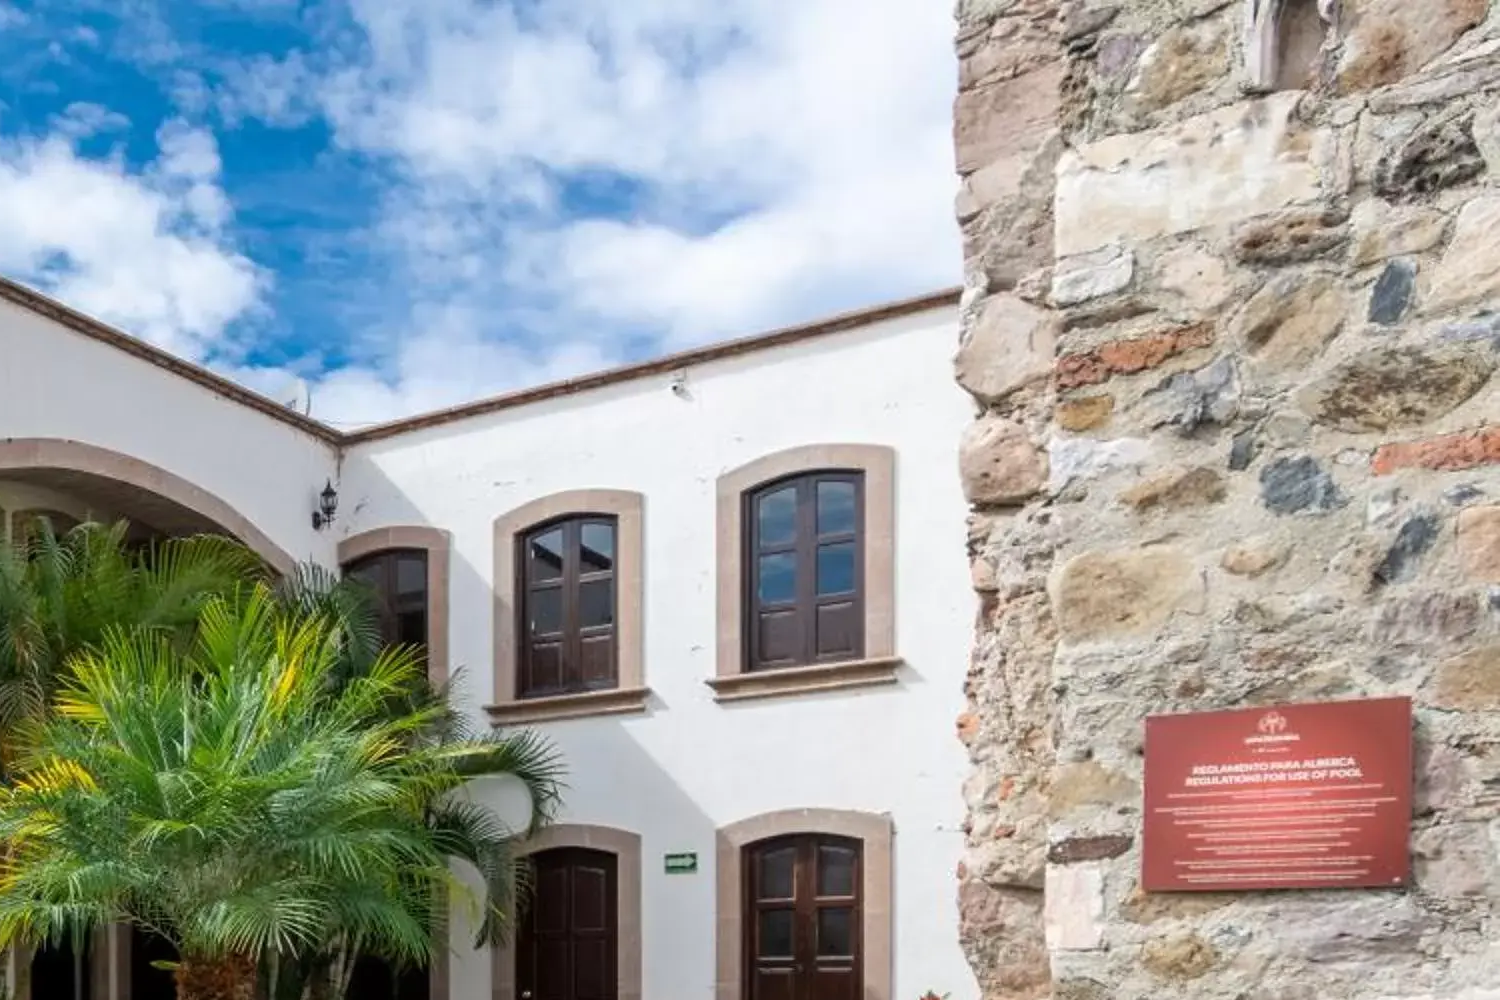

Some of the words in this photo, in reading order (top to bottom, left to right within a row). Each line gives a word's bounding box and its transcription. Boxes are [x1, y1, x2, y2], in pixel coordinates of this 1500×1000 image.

[1193, 763, 1269, 774] REGLAMENTO
[1271, 761, 1300, 770] PARA
[1303, 757, 1355, 767] ALBERCA
[1185, 775, 1262, 786] REGULATIONS
[1264, 773, 1286, 782] FOR
[1288, 771, 1310, 782] USE
[1311, 770, 1328, 780] OF
[1329, 768, 1363, 778] POOL
